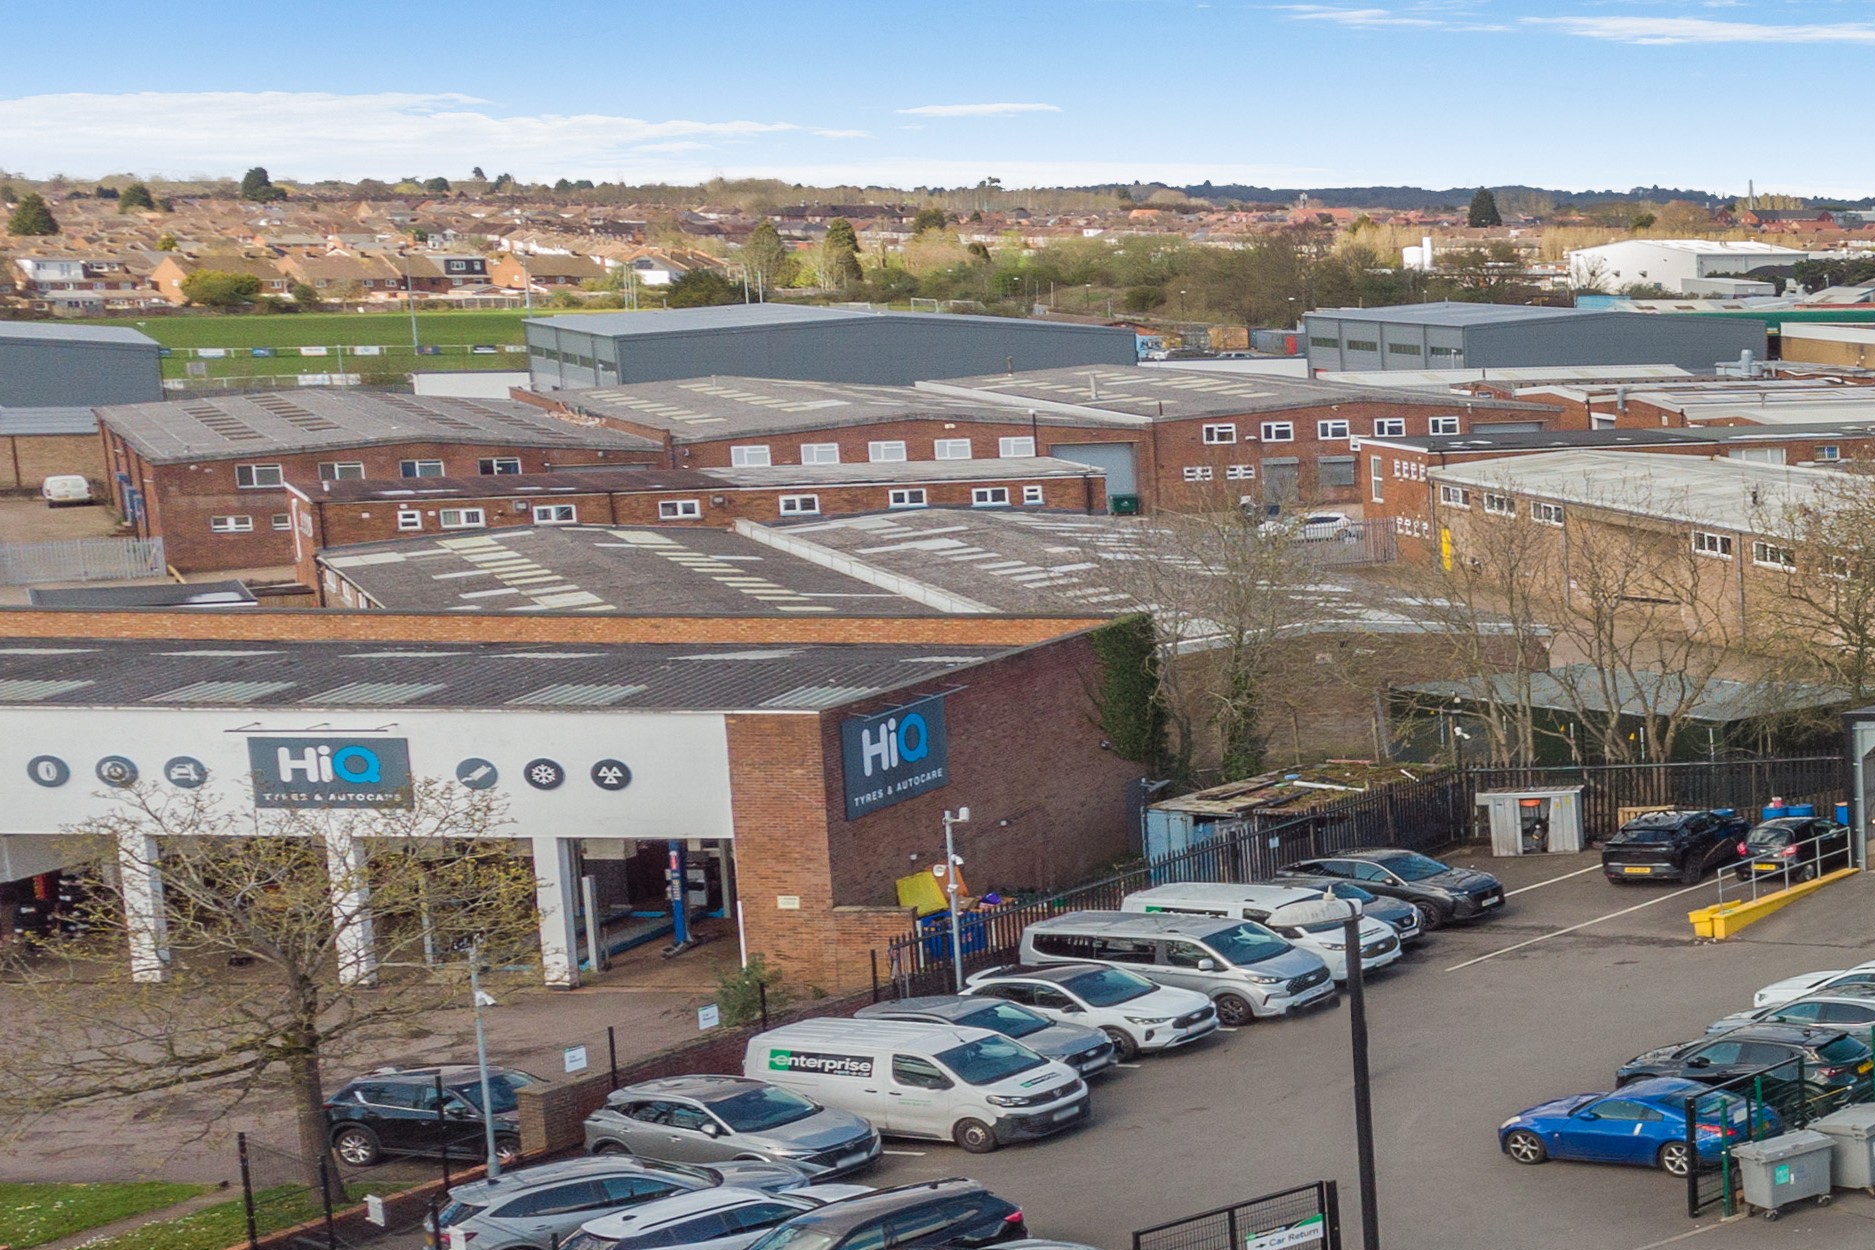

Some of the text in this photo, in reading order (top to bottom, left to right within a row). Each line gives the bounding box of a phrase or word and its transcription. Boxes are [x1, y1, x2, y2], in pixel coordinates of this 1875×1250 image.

[862, 712, 928, 777] HiQ
[277, 745, 381, 784] HiQ
[263, 793, 309, 801] TES
[854, 768, 943, 807] TYRES & AUTOCARE
[770, 1054, 872, 1072] enterprise
[1269, 1238, 1285, 1246] Car
[1288, 1228, 1319, 1241] Return
